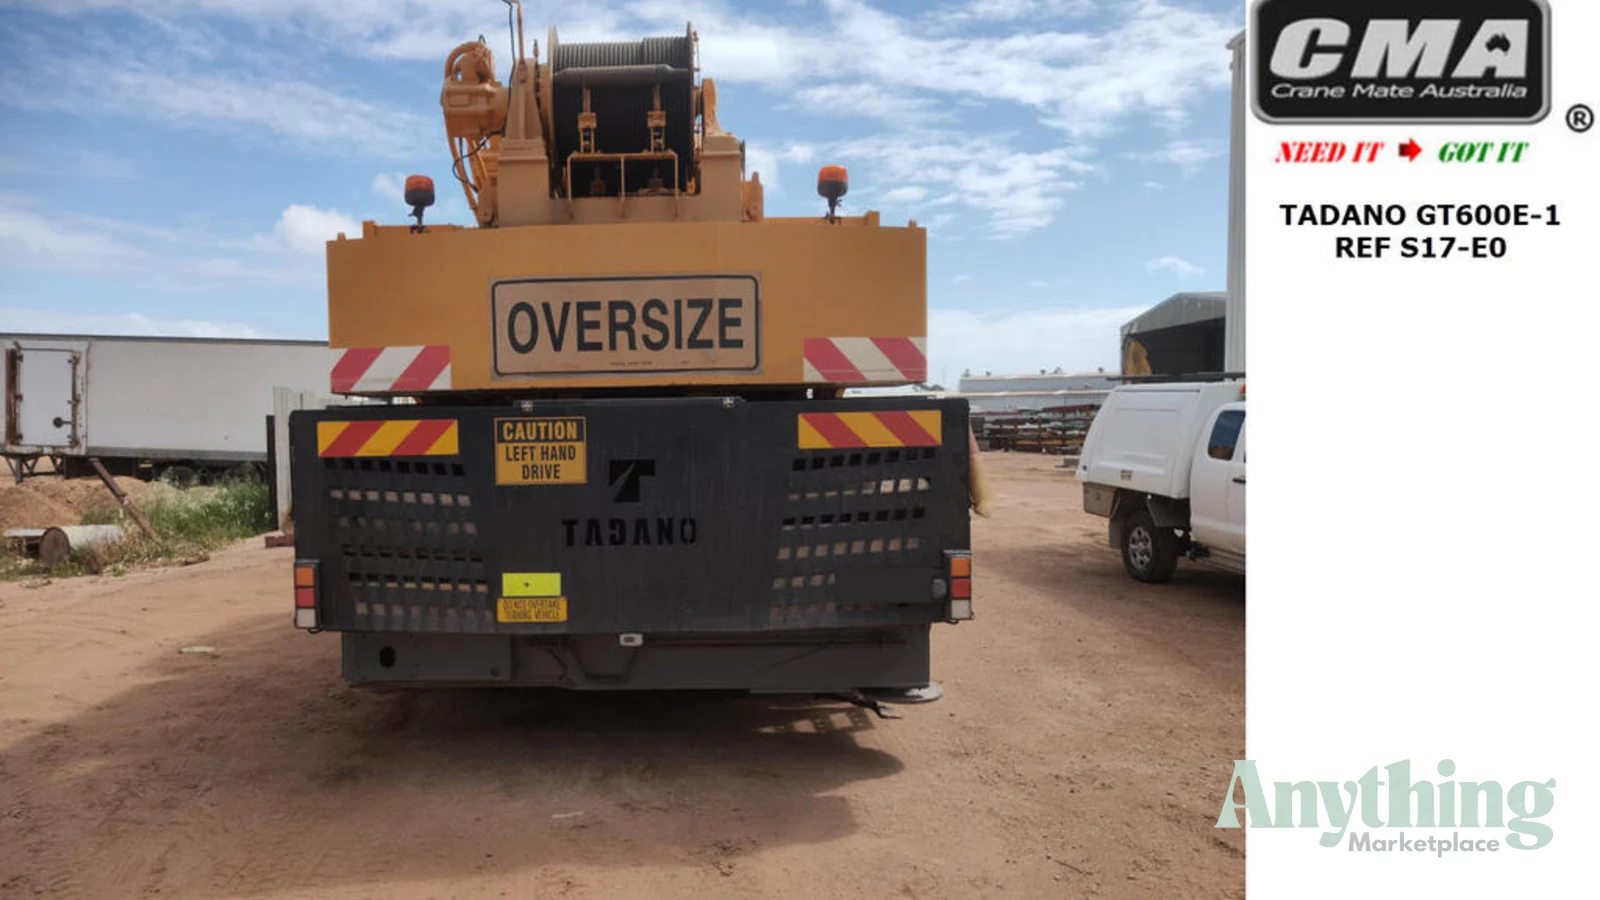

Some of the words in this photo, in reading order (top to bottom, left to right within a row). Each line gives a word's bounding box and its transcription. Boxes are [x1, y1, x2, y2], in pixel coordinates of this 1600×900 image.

[507, 298, 744, 354] OVERSIZE
[503, 421, 577, 441] CAUTION
[505, 445, 536, 462] LEFT
[541, 445, 576, 461] HAND
[522, 463, 561, 480] DRIVE
[562, 517, 697, 547] TADANO
